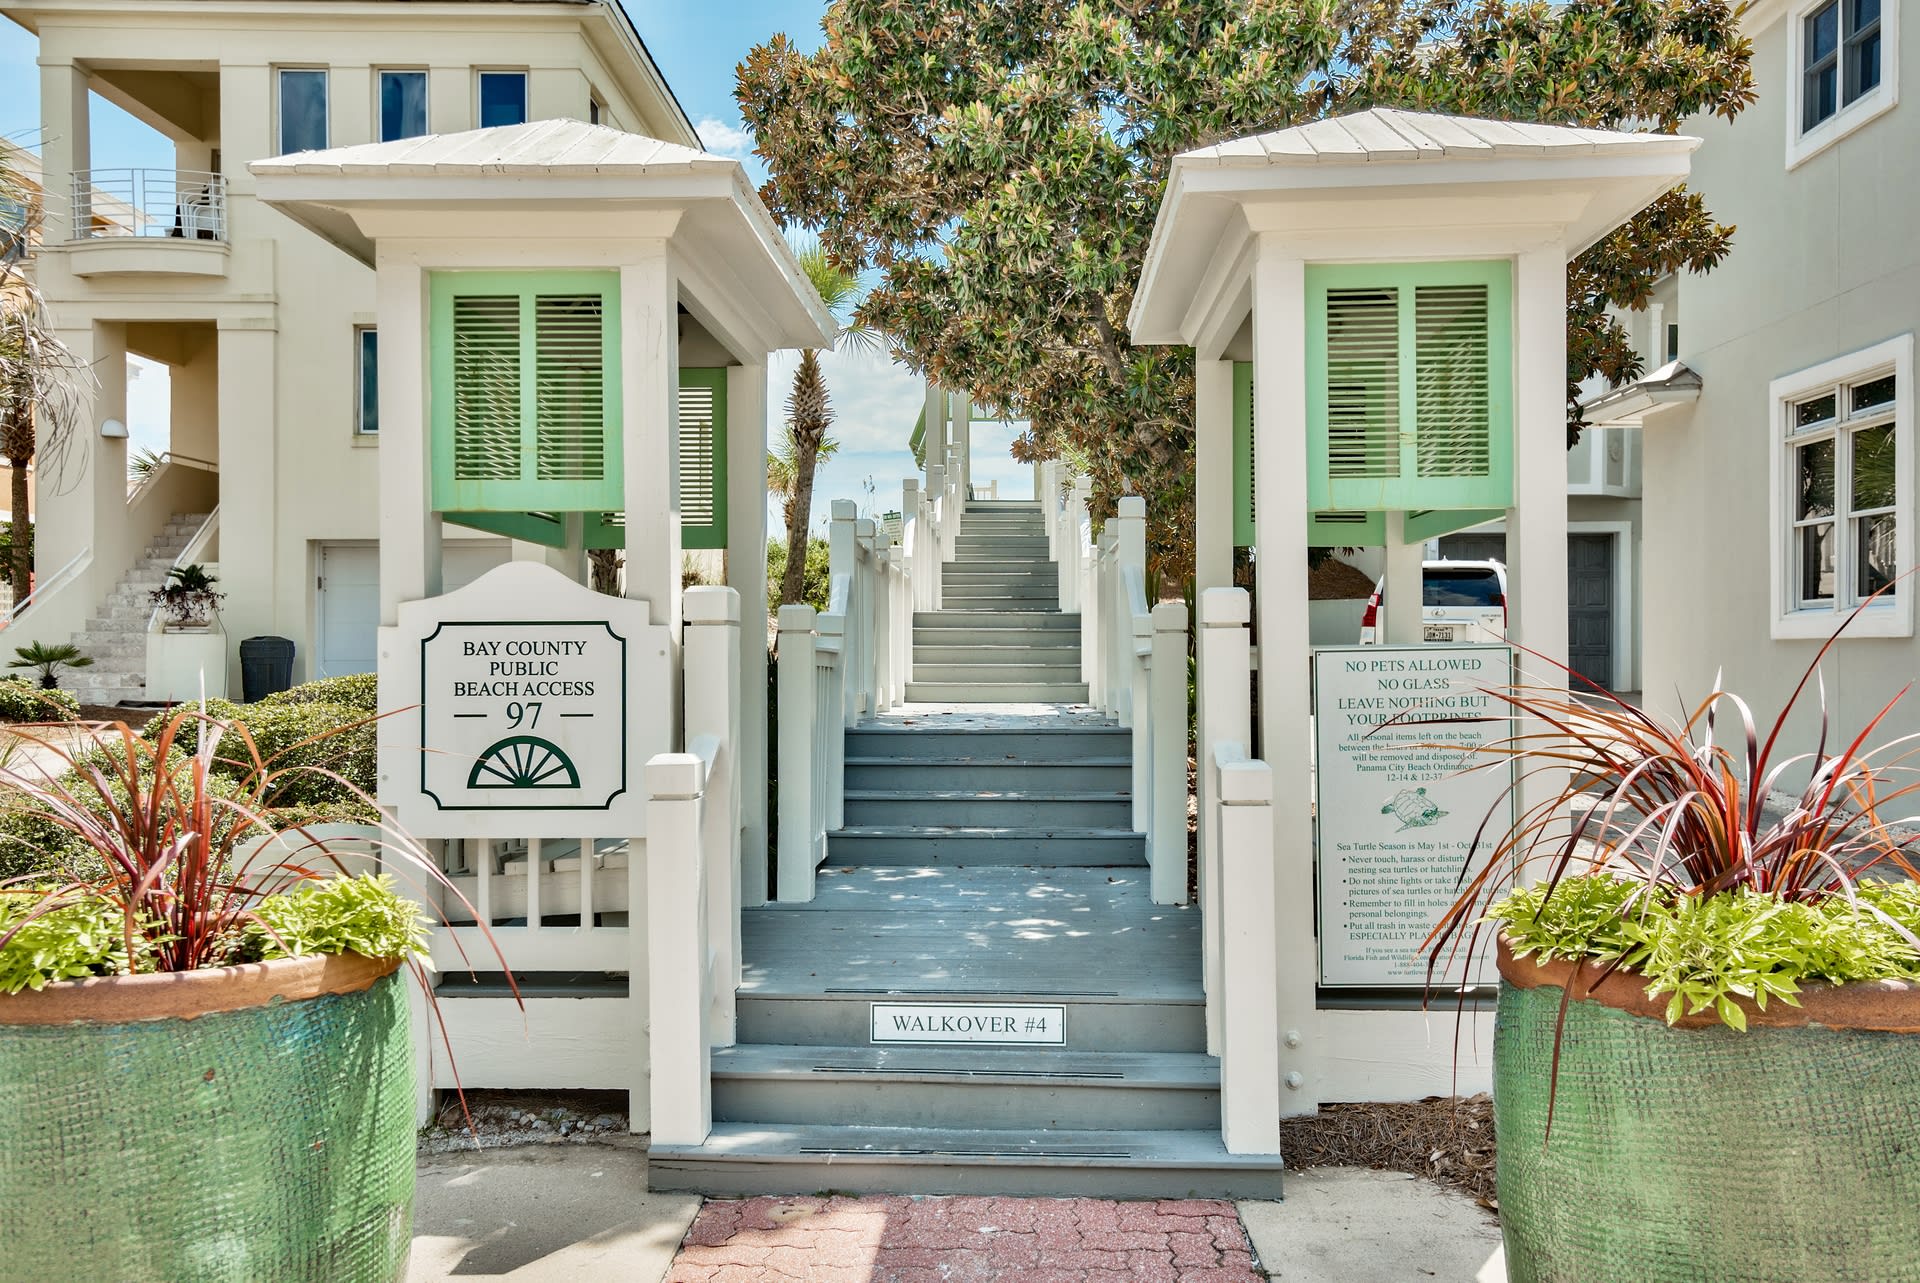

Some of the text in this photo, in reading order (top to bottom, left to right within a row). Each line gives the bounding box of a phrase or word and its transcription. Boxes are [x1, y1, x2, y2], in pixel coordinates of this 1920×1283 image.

[463, 640, 587, 656] BAY COUNTY
[489, 661, 559, 676] PUBLIC
[1345, 659, 1482, 672] NO PETS ALLOWED
[454, 681, 595, 697] BEACH ACCESS
[1378, 678, 1450, 690] NO GLASS
[1338, 695, 1489, 709] LEAVE NOTHING BUT
[506, 701, 543, 730] 97
[1347, 711, 1482, 725] YOUR FOOTPRINTS
[1347, 733, 1359, 741] All
[1361, 733, 1393, 743] personal
[1396, 733, 1416, 741] items
[1418, 732, 1432, 740] left
[1445, 732, 1457, 740] the
[1459, 732, 1482, 740] beach
[1338, 743, 1371, 751] between
[1372, 743, 1384, 751] the
[1352, 753, 1367, 761] will
[1369, 753, 1378, 761] be
[1380, 753, 1413, 761] removed
[1415, 753, 1429, 761] and
[1431, 752, 1465, 762] disposed
[1388, 763, 1405, 773] City
[1407, 763, 1431, 771] Beach
[1433, 762, 1473, 771] Ordinance
[1410, 773, 1418, 781] &
[1421, 773, 1443, 781] 12-37
[1336, 842, 1351, 851] Sea
[1353, 842, 1376, 851] Turtle
[1379, 842, 1406, 850] Season
[1408, 842, 1415, 850] is
[1417, 842, 1435, 851] May
[1438, 841, 1449, 849] 1st
[1348, 855, 1372, 863] Never
[1374, 855, 1398, 864] touch,
[1400, 855, 1425, 863] harass
[1437, 854, 1465, 862] disturb
[1348, 866, 1376, 875] nesting
[1393, 865, 1418, 873] turtles
[1430, 865, 1473, 874] hatchlins.
[1349, 877, 1361, 885] Do
[1377, 877, 1398, 885] shine
[1400, 876, 1422, 886] lights
[1435, 876, 1451, 884] take
[1349, 888, 1379, 897] pictures
[1381, 887, 1391, 895] of
[1407, 887, 1431, 895] turtles
[1349, 899, 1391, 907] Remember
[1404, 899, 1415, 907] fill
[1417, 899, 1425, 907] in
[1427, 898, 1448, 907] holes
[1349, 909, 1382, 919] personal
[1350, 922, 1363, 930] Put
[1364, 921, 1375, 929] all
[1377, 921, 1396, 929] trash
[1398, 921, 1406, 929] in
[1350, 932, 1406, 940] ESPECIALLY
[893, 1015, 1047, 1033] WALKOVER #4
